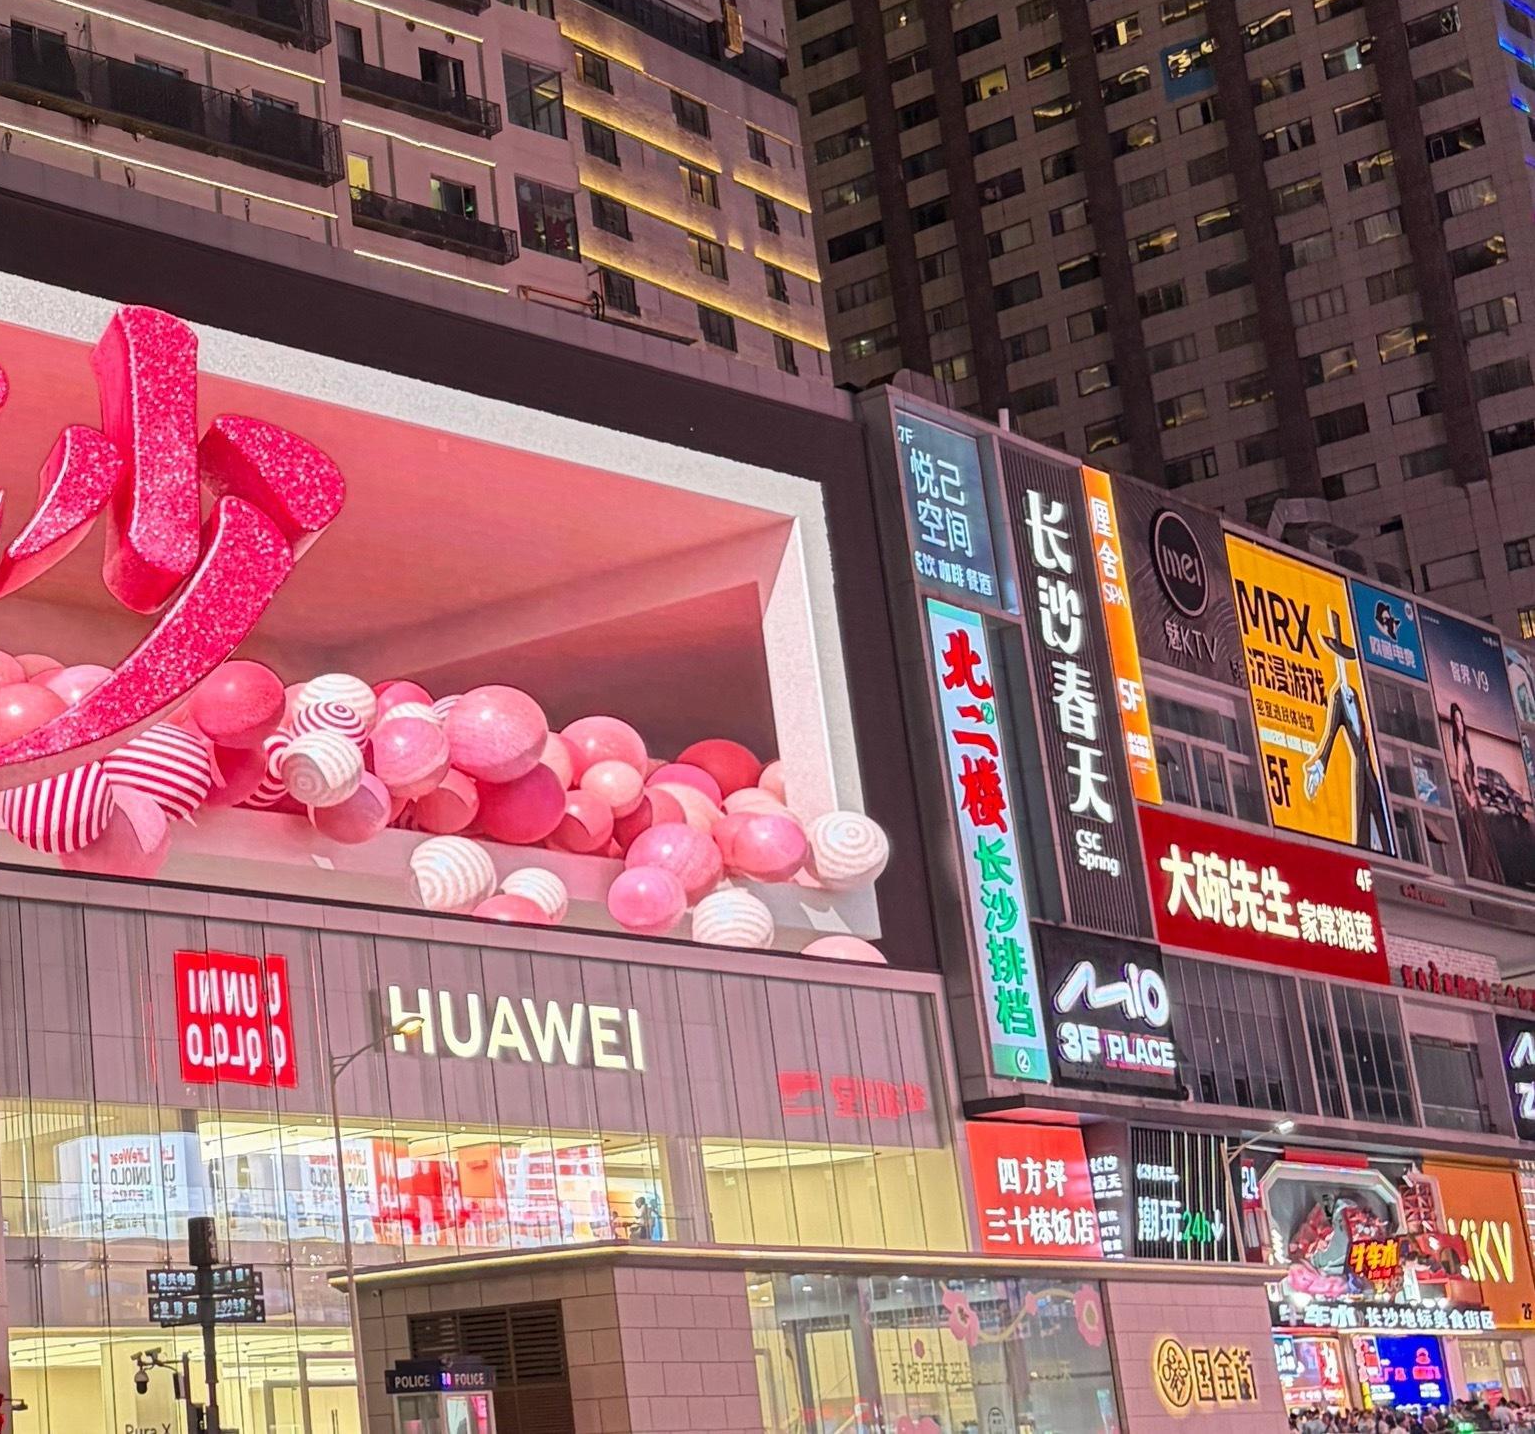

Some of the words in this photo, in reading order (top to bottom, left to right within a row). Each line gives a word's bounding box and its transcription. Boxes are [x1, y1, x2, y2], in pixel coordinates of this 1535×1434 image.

[911, 448, 966, 507] 悦己
[917, 499, 973, 559] 空间
[1103, 582, 1128, 608] SPA
[1234, 578, 1320, 660] MRX
[1025, 489, 1114, 824] 长沙春天
[1118, 677, 1142, 712] 5F
[1267, 754, 1292, 808] 5F
[1075, 829, 1103, 851] CSC
[1078, 847, 1121, 878] Spring
[1160, 844, 1300, 941] 大碗先生
[974, 834, 1037, 1039] 长沙排档
[1296, 899, 1378, 954] 家常湘菜
[387, 984, 646, 1071] HUAWEI
[1103, 1033, 1178, 1070] PLACE
[997, 1156, 1069, 1198] 四方坪
[984, 1205, 1097, 1246] 三十栋饭店
[394, 1374, 432, 1389] POLICE
[454, 1372, 485, 1386] POLICE
